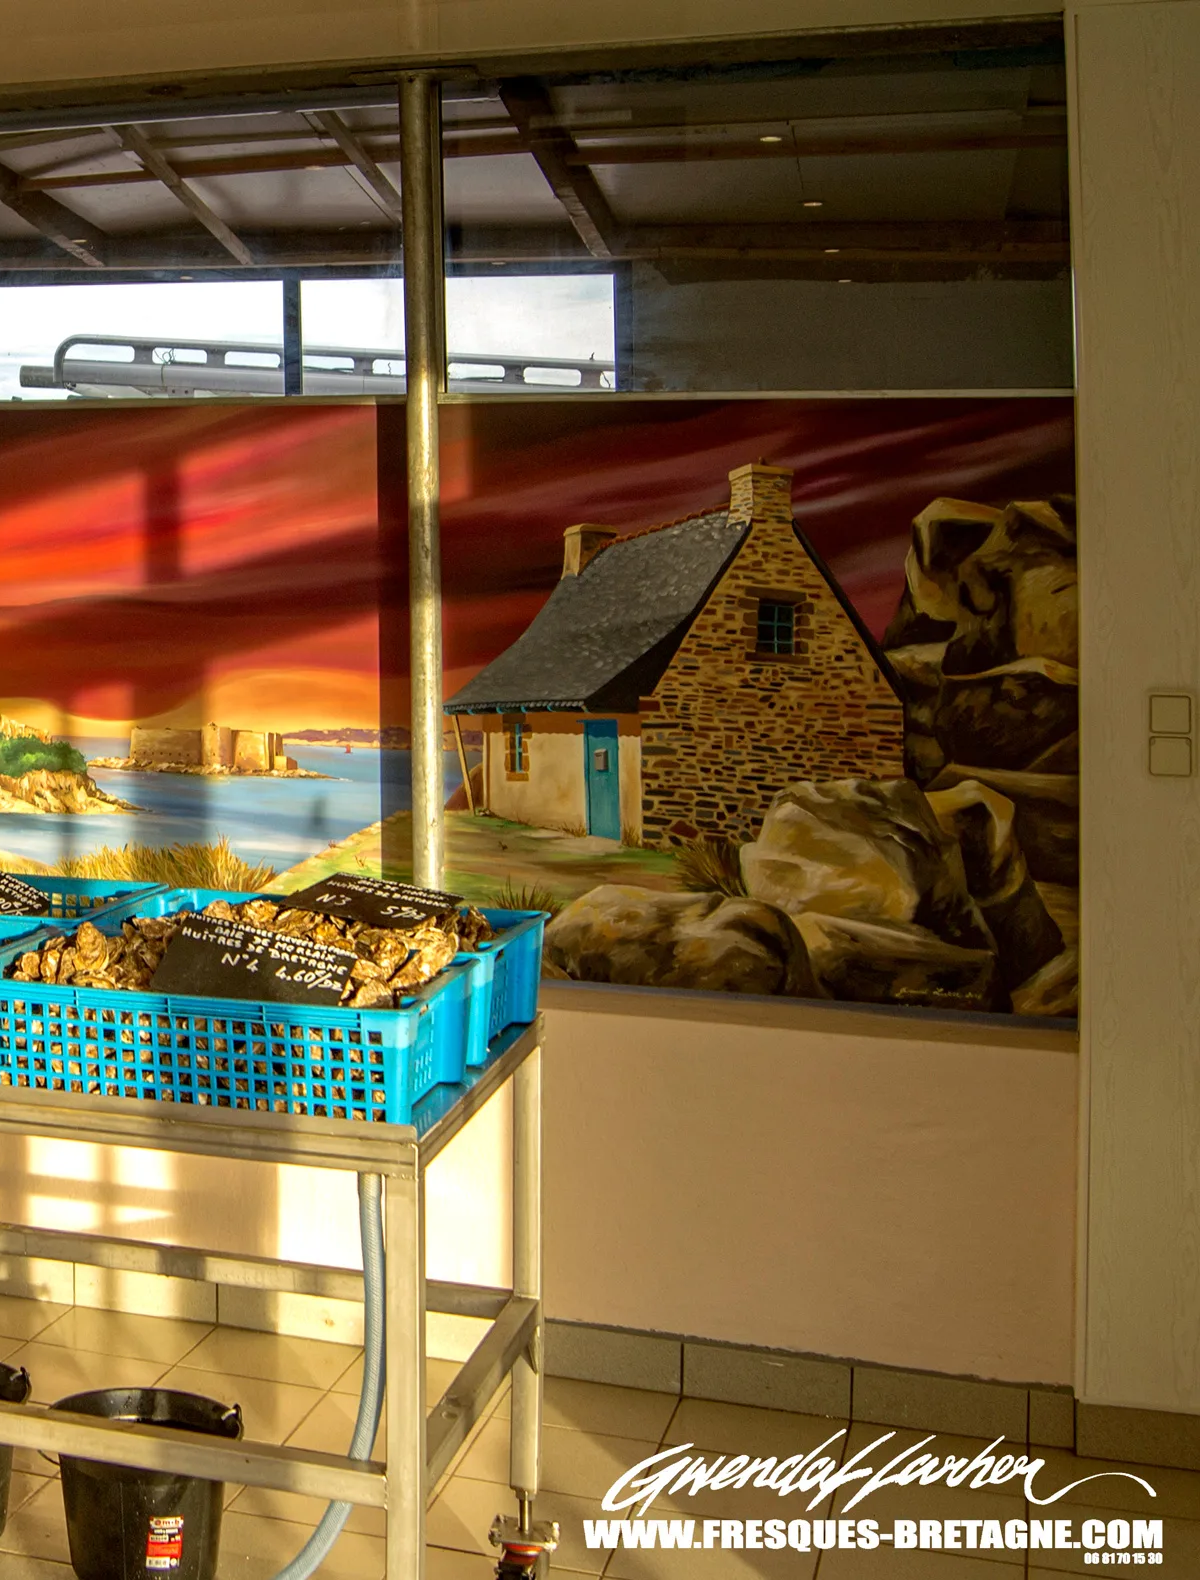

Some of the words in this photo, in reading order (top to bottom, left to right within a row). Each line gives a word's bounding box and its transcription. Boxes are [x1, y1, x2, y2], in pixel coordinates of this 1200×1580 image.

[214, 926, 245, 941] BAIE
[252, 936, 272, 948] DE
[246, 942, 265, 955] DE
[268, 947, 348, 976] BRETAGNE
